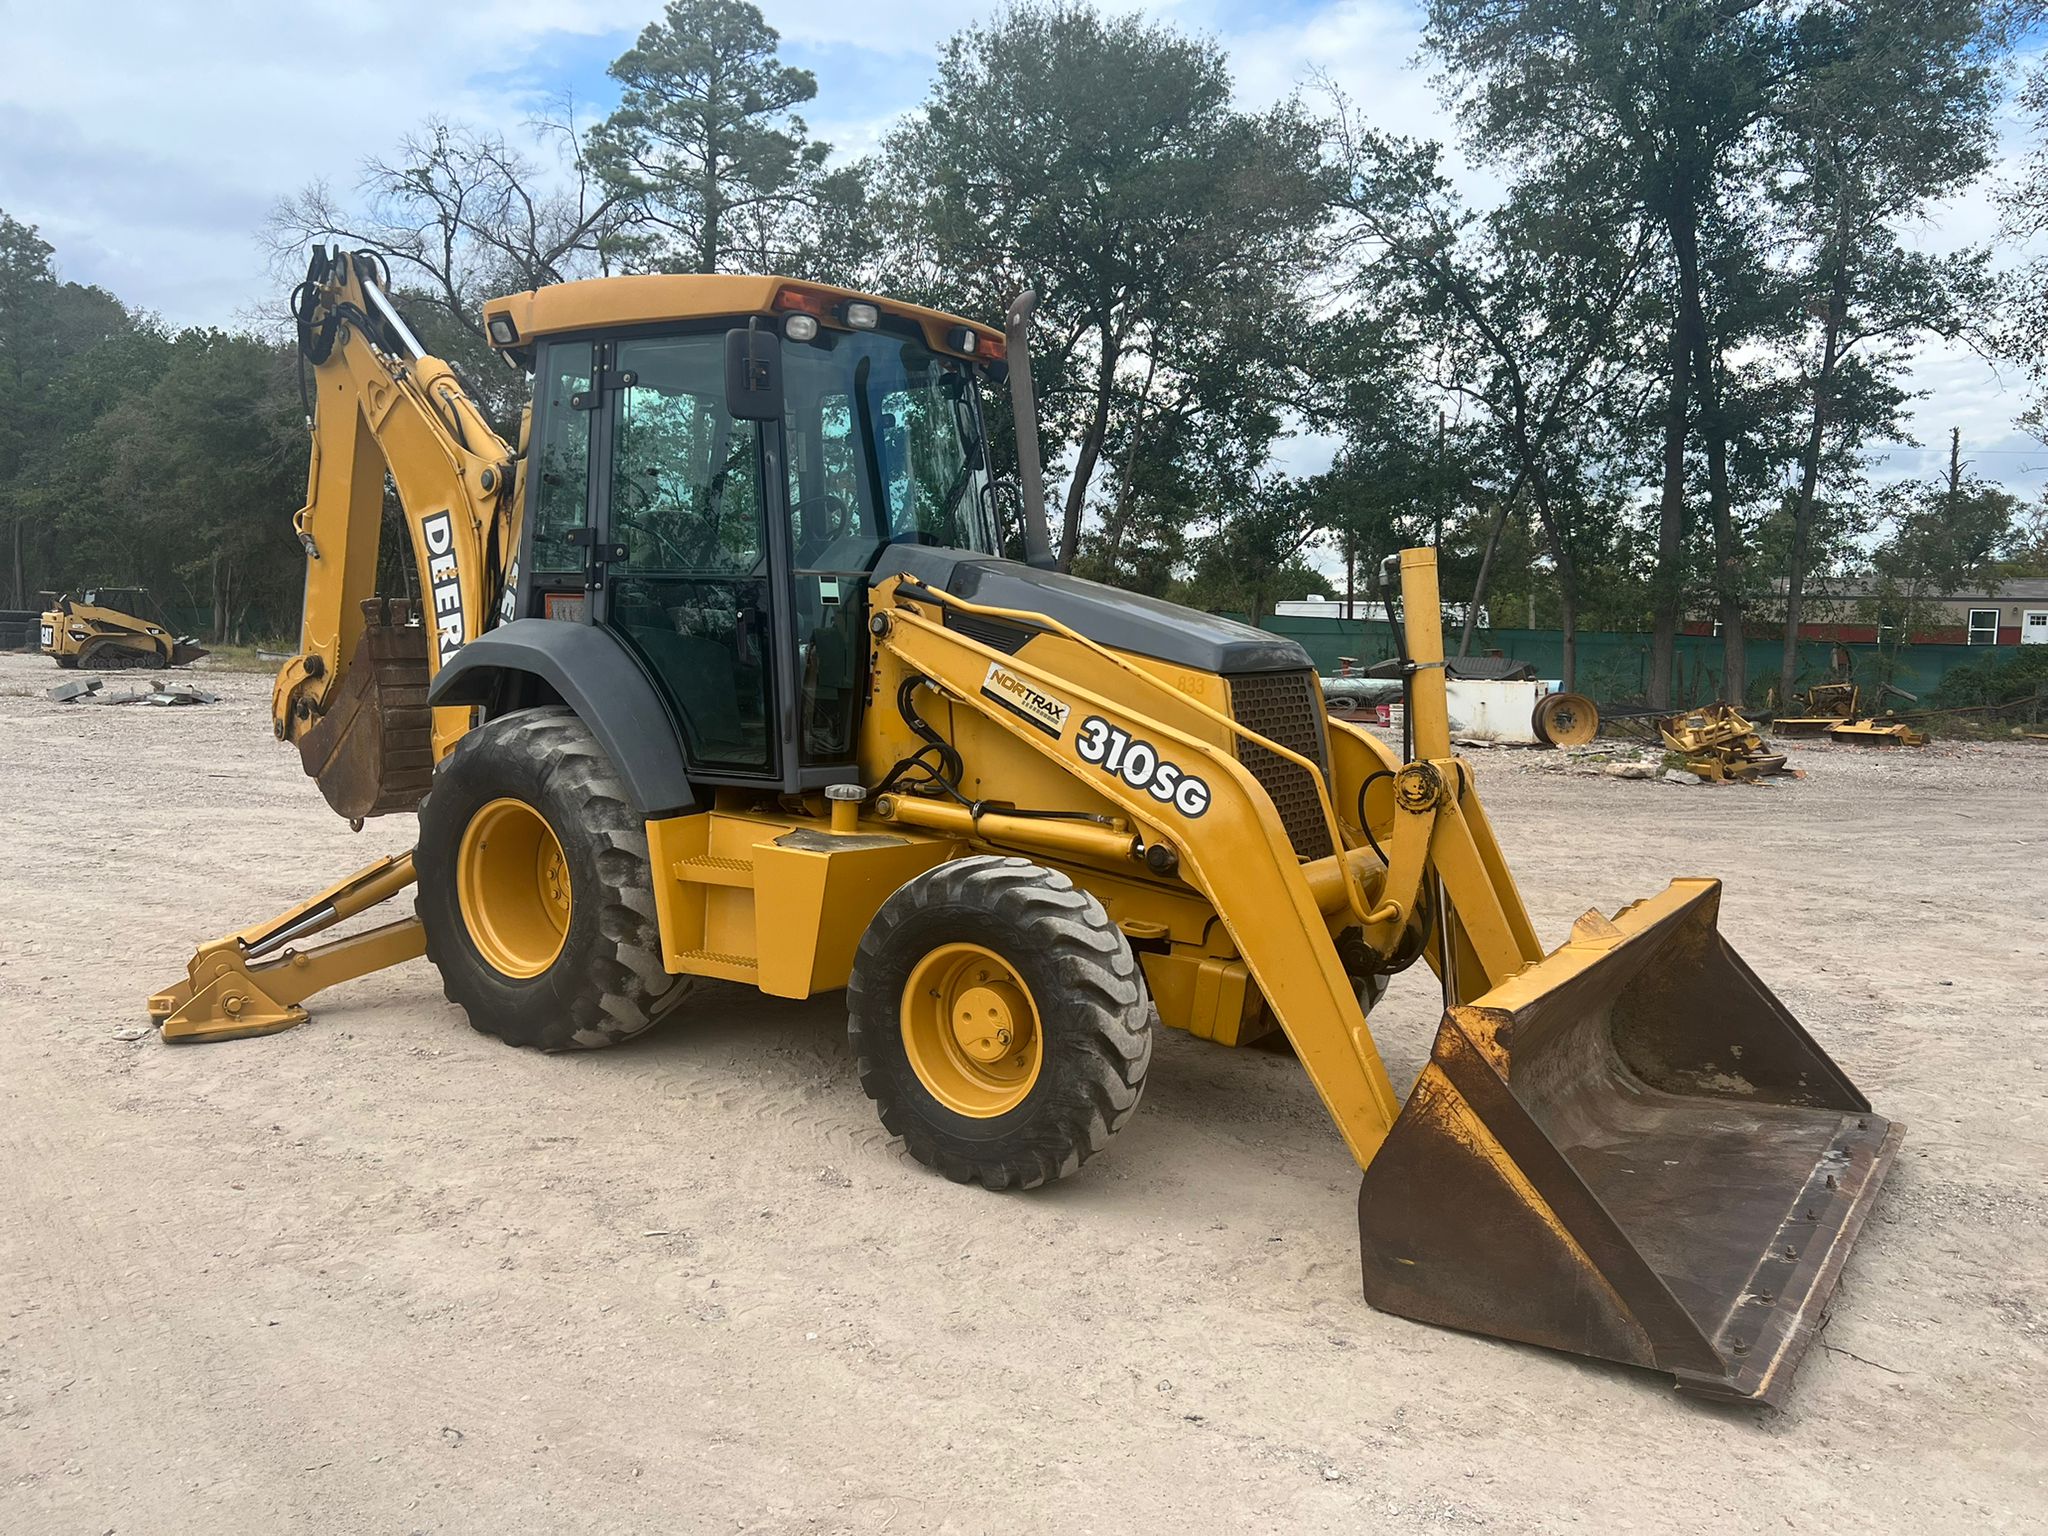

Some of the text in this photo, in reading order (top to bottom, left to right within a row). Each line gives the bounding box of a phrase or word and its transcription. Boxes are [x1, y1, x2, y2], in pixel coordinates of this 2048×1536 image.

[424, 514, 463, 667] DEER
[990, 669, 1065, 720] NORTRAX
[1177, 675, 1205, 695] 833
[1077, 717, 1209, 816] 310SG
